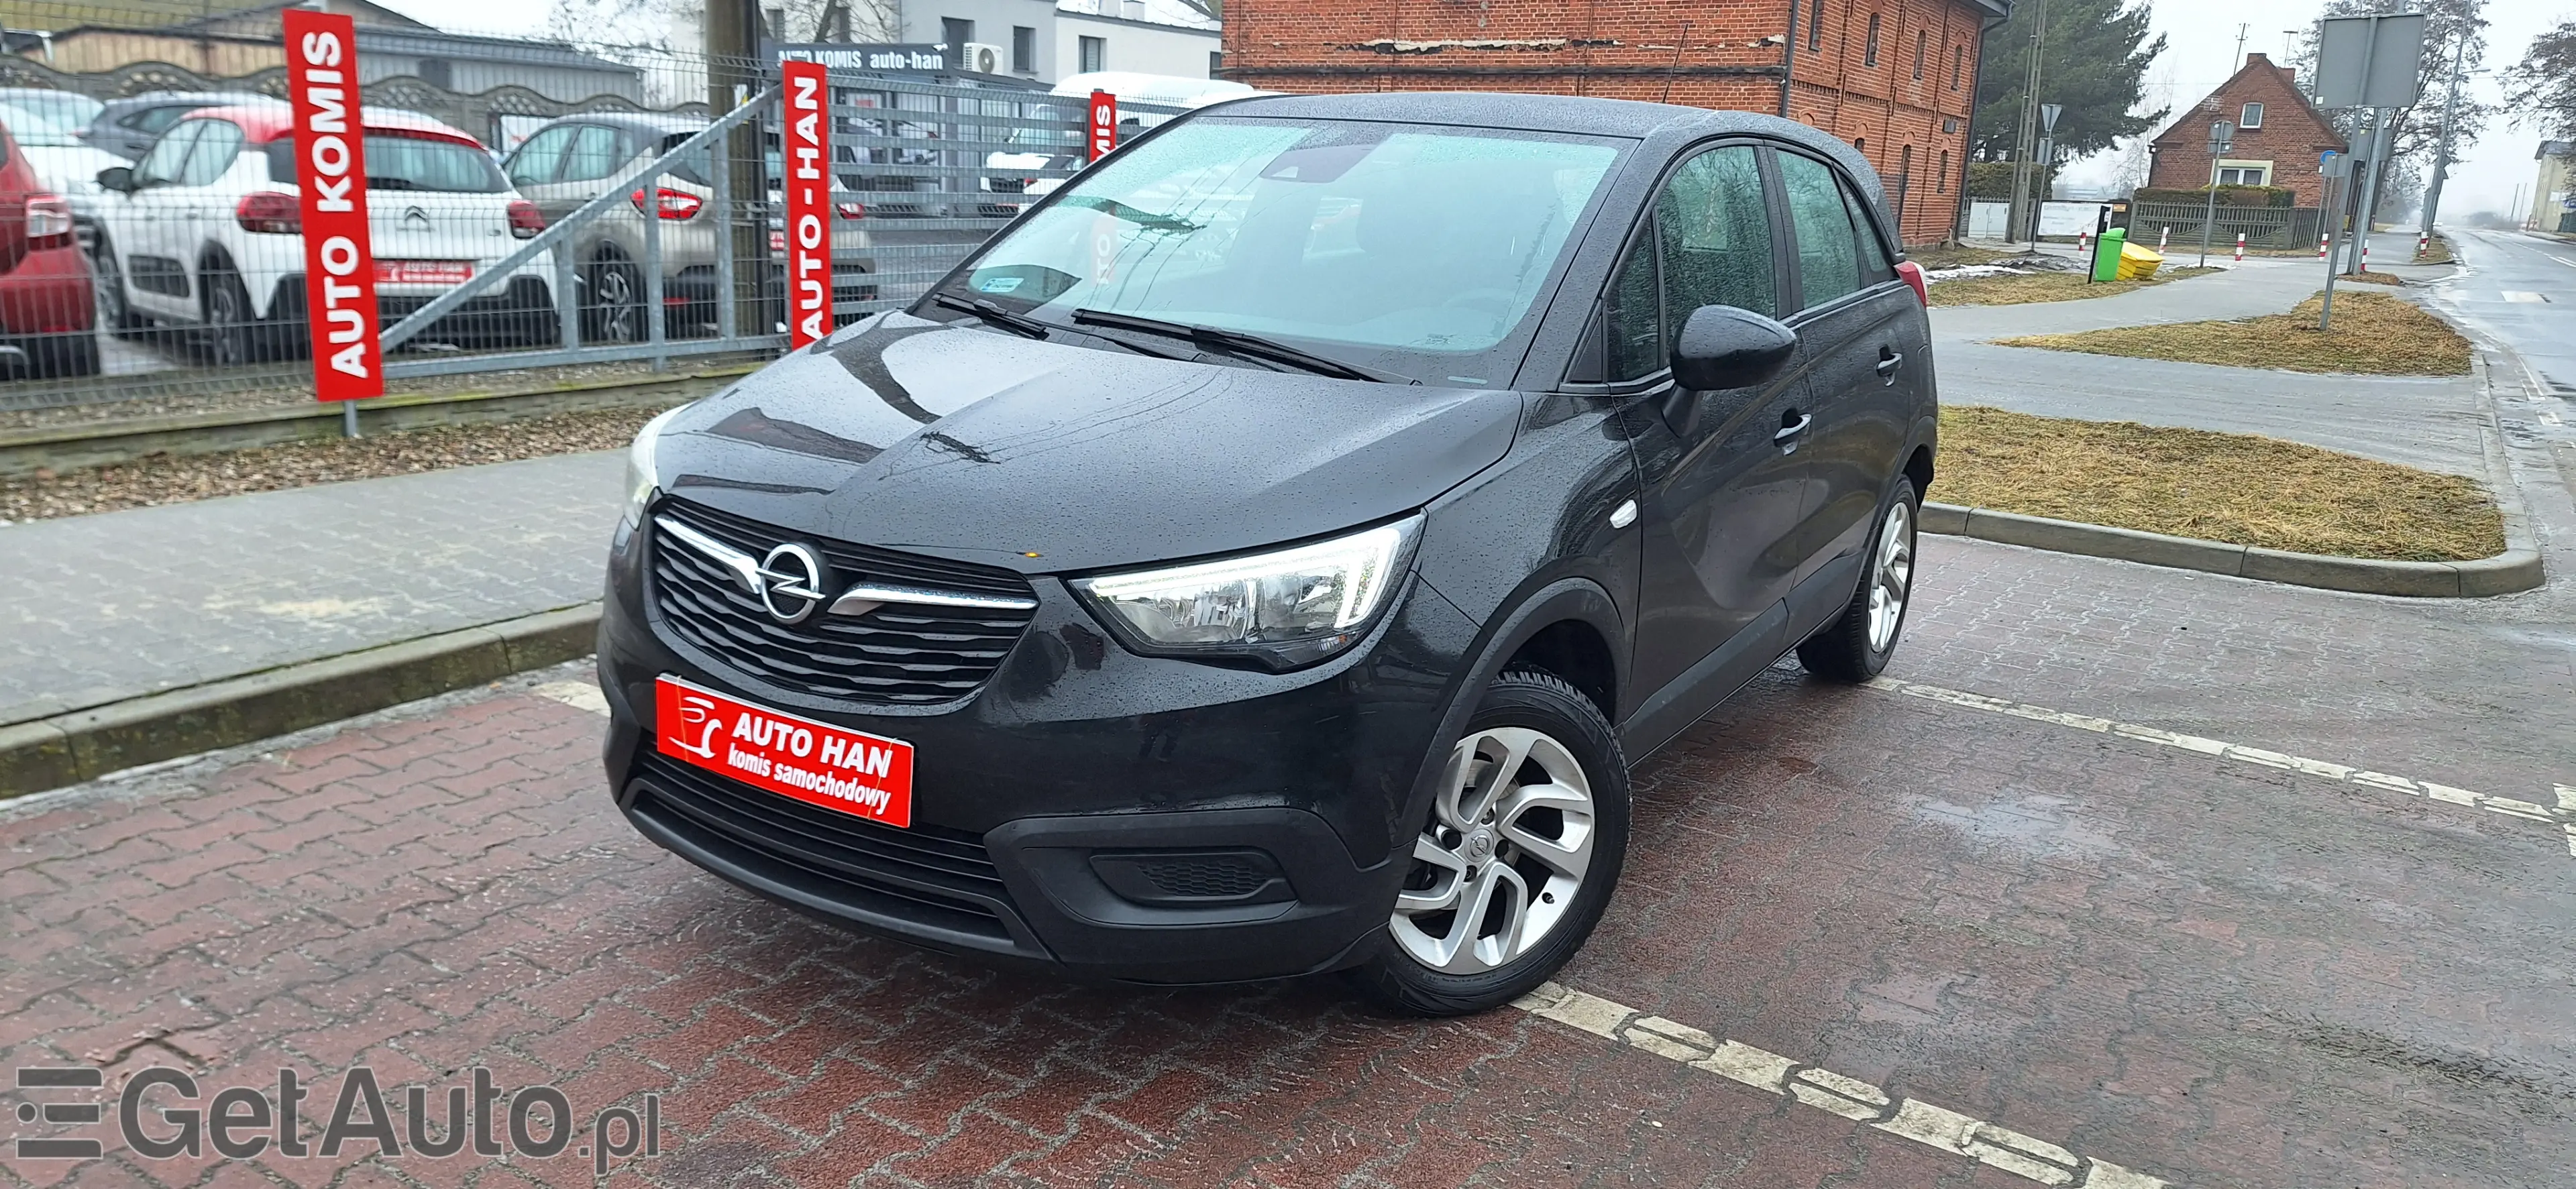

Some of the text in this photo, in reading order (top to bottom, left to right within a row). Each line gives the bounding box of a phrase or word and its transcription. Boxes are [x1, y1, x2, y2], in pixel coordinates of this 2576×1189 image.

[815, 50, 861, 68] KOMIS
[870, 52, 943, 70] auto-han
[1096, 105, 1111, 160] MIS
[303, 32, 368, 378] AUTO KOMIS
[732, 712, 893, 778] AUTO HAN
[728, 742, 891, 815] komis samochodowy
